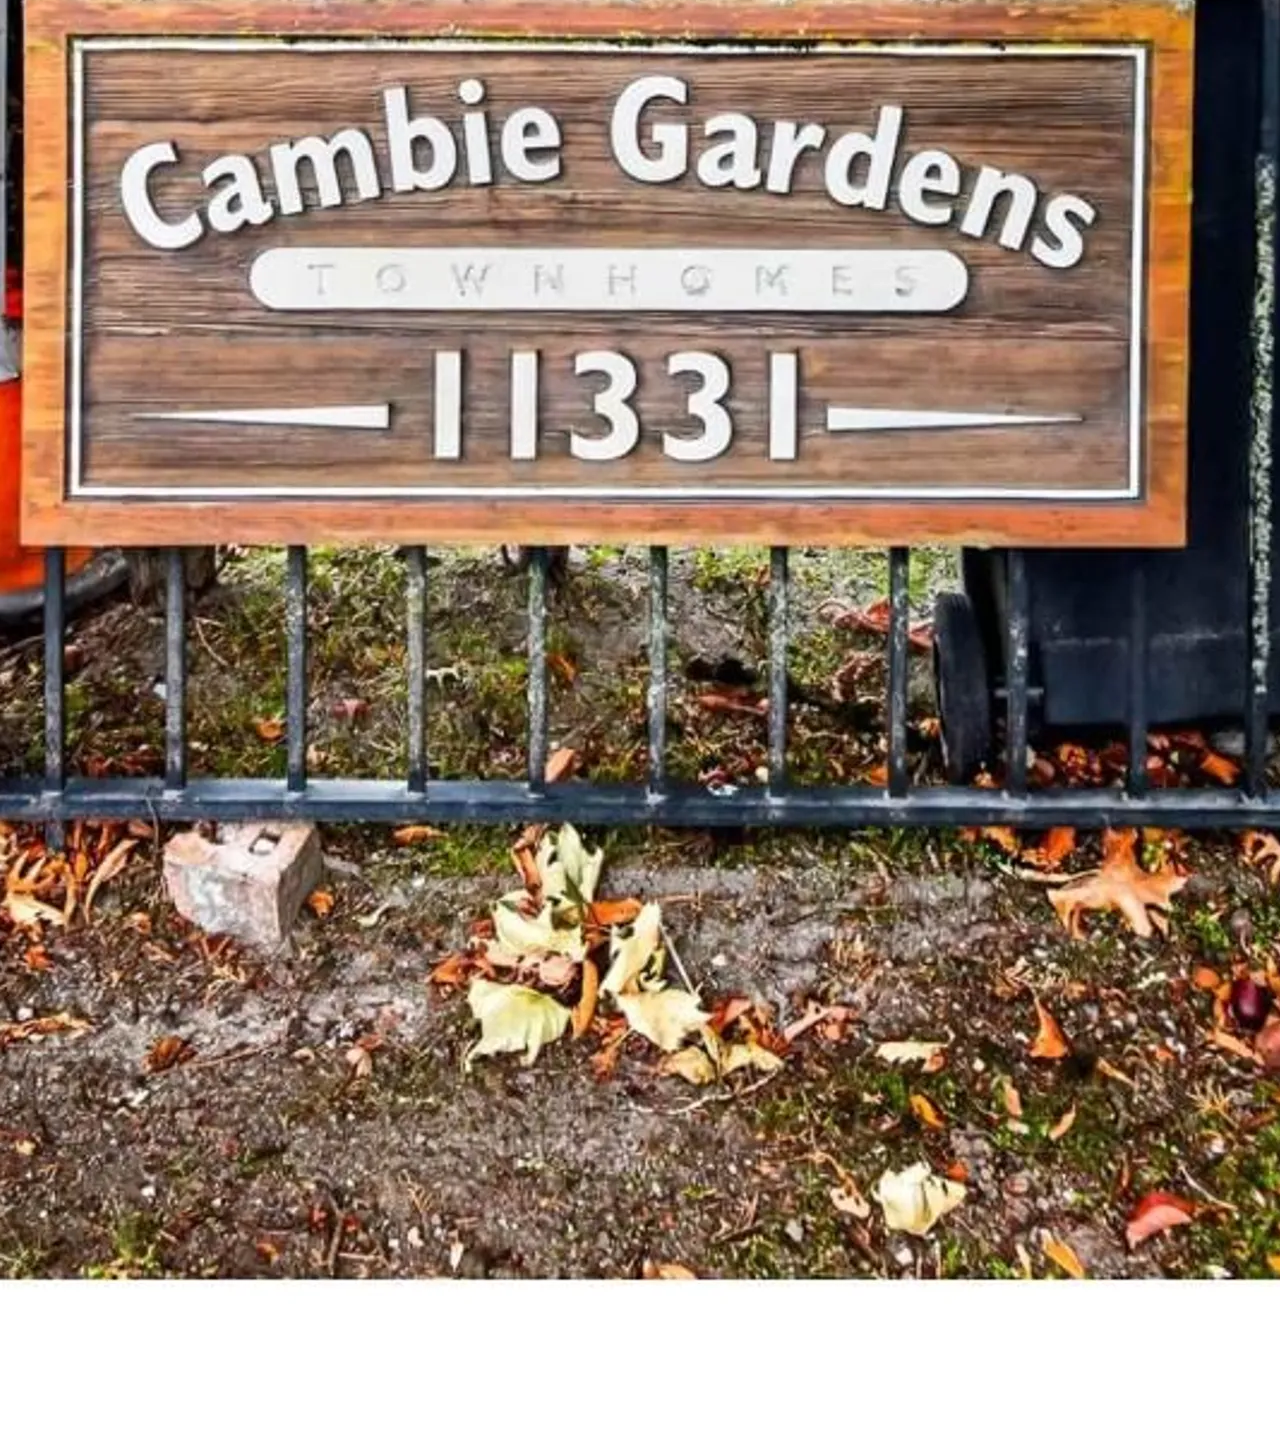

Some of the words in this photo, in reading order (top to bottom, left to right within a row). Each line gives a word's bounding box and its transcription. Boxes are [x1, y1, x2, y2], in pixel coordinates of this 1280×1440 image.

[120, 78, 563, 250] Cambie
[610, 75, 1097, 268] Gardens
[306, 263, 923, 297] TOWNHOMES
[432, 349, 799, 460] 11331
